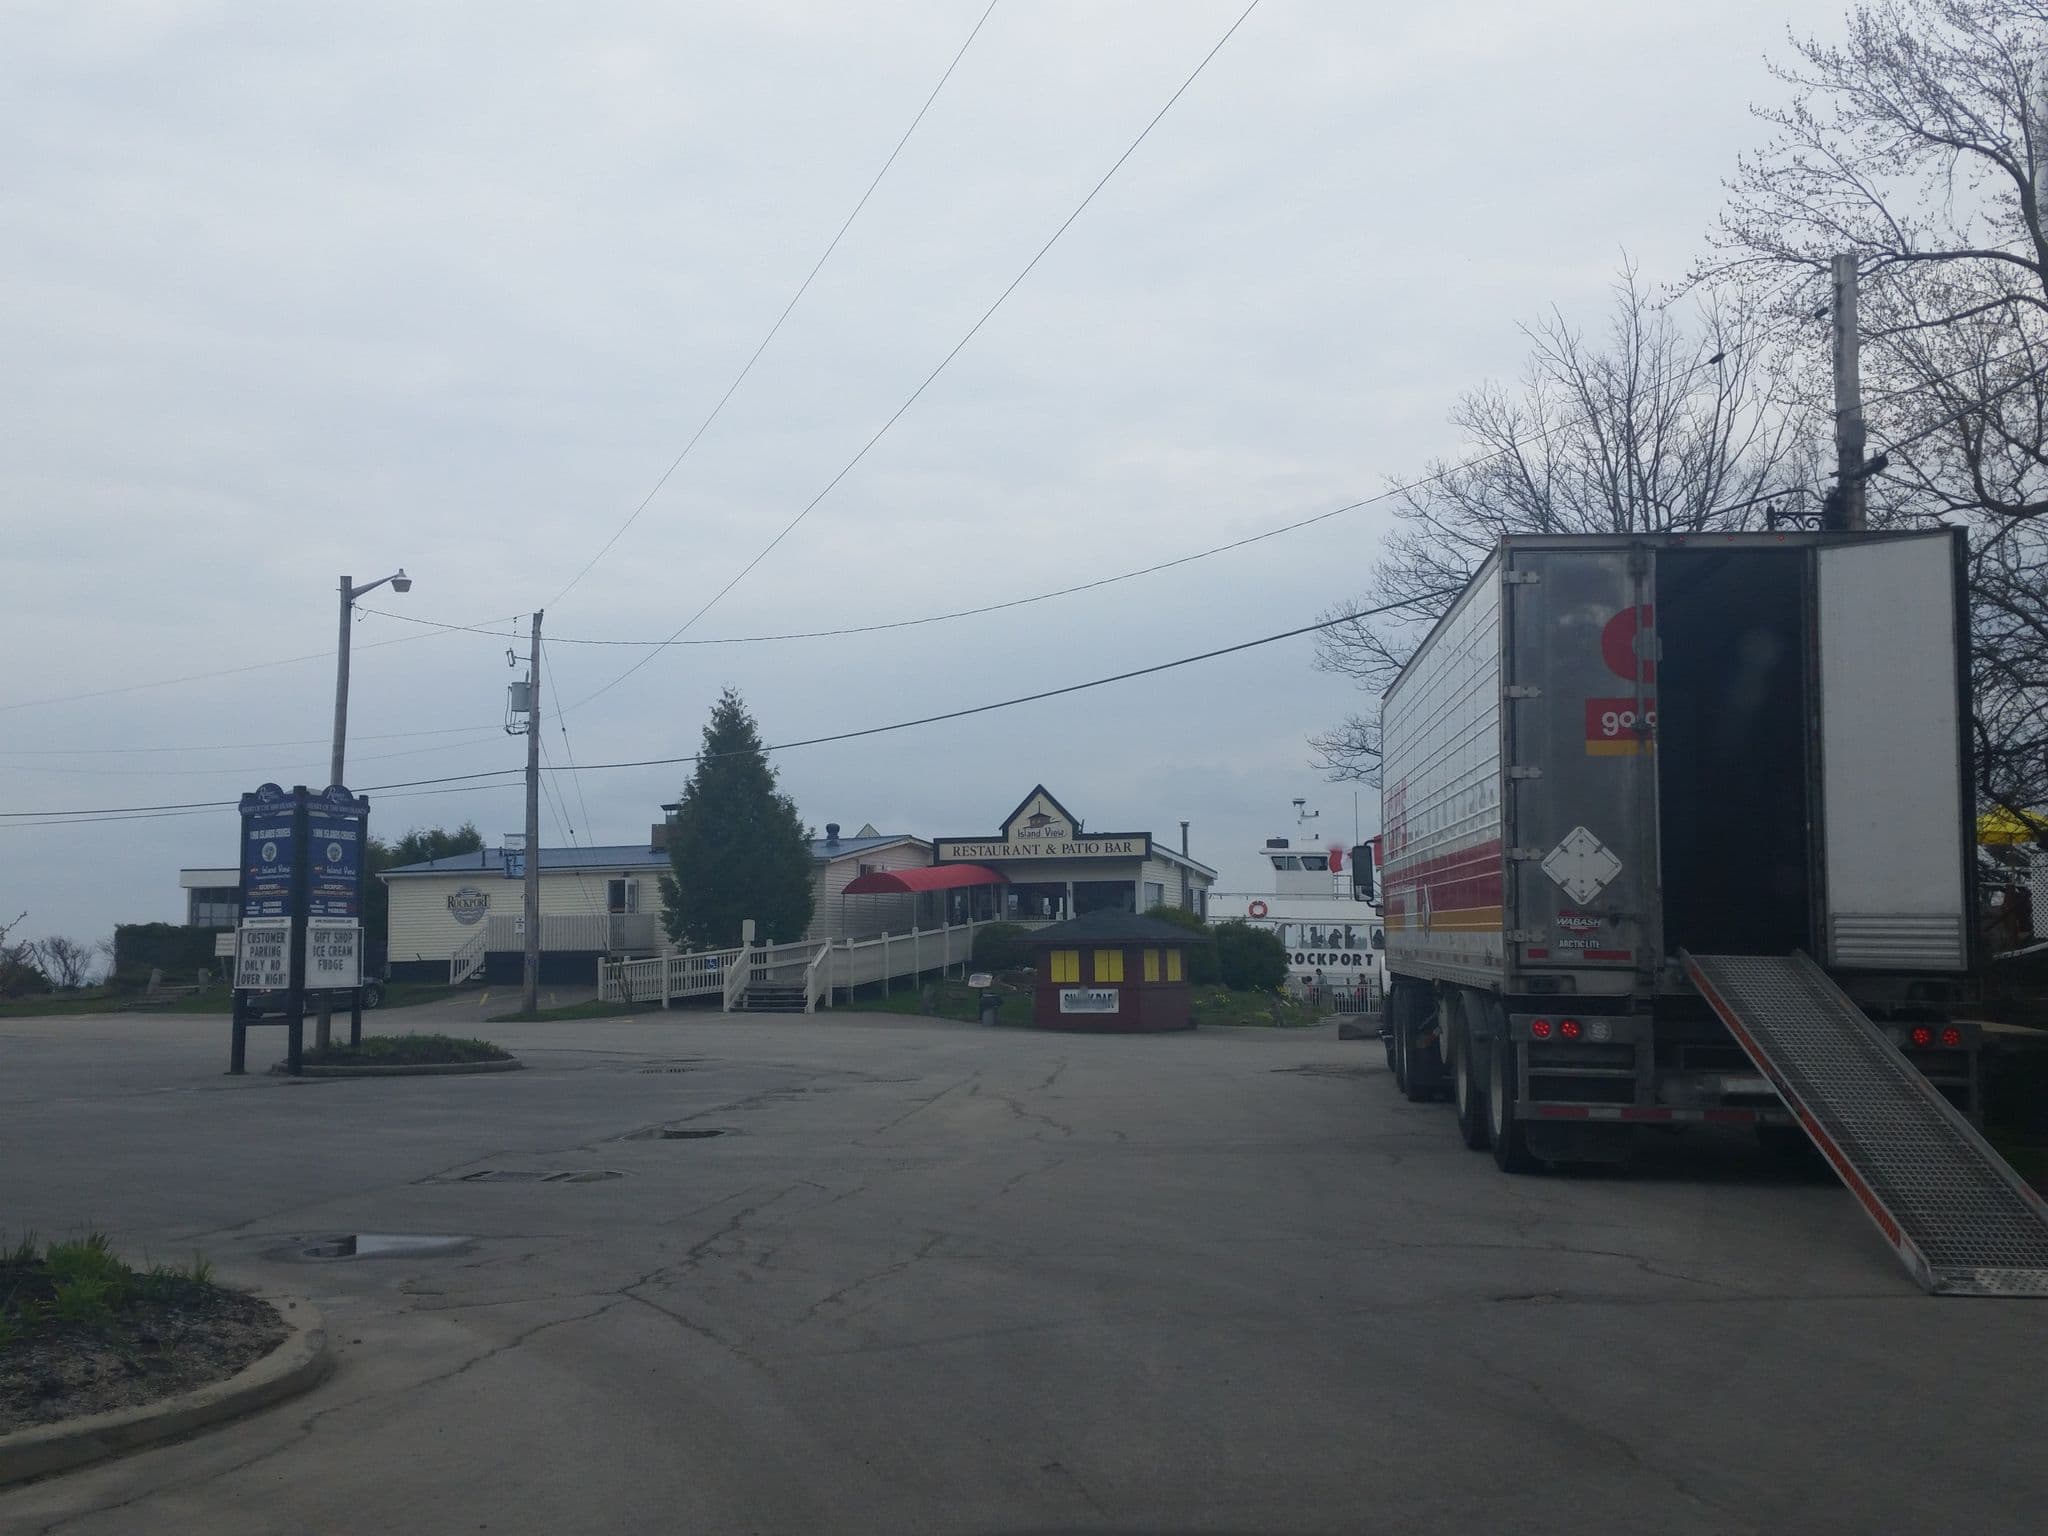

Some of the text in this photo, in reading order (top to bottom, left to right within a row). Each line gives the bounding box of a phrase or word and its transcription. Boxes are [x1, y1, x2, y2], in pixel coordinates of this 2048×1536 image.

[1017, 827, 1064, 837] Island View
[953, 841, 1132, 857] RESTAURANT & PATIO BAR
[1557, 918, 1601, 926] WABASH
[247, 932, 286, 944] CUSTOMER
[314, 931, 352, 943] GIFT SHOP
[1559, 940, 1585, 949] ARCTIC
[250, 946, 281, 957] PARKING
[313, 945, 353, 957] ICE CREAM
[1284, 953, 1374, 966] ROCKPORT
[245, 960, 281, 971] ONLY NO
[319, 960, 344, 971] FUDGE
[241, 974, 260, 984] OVER
